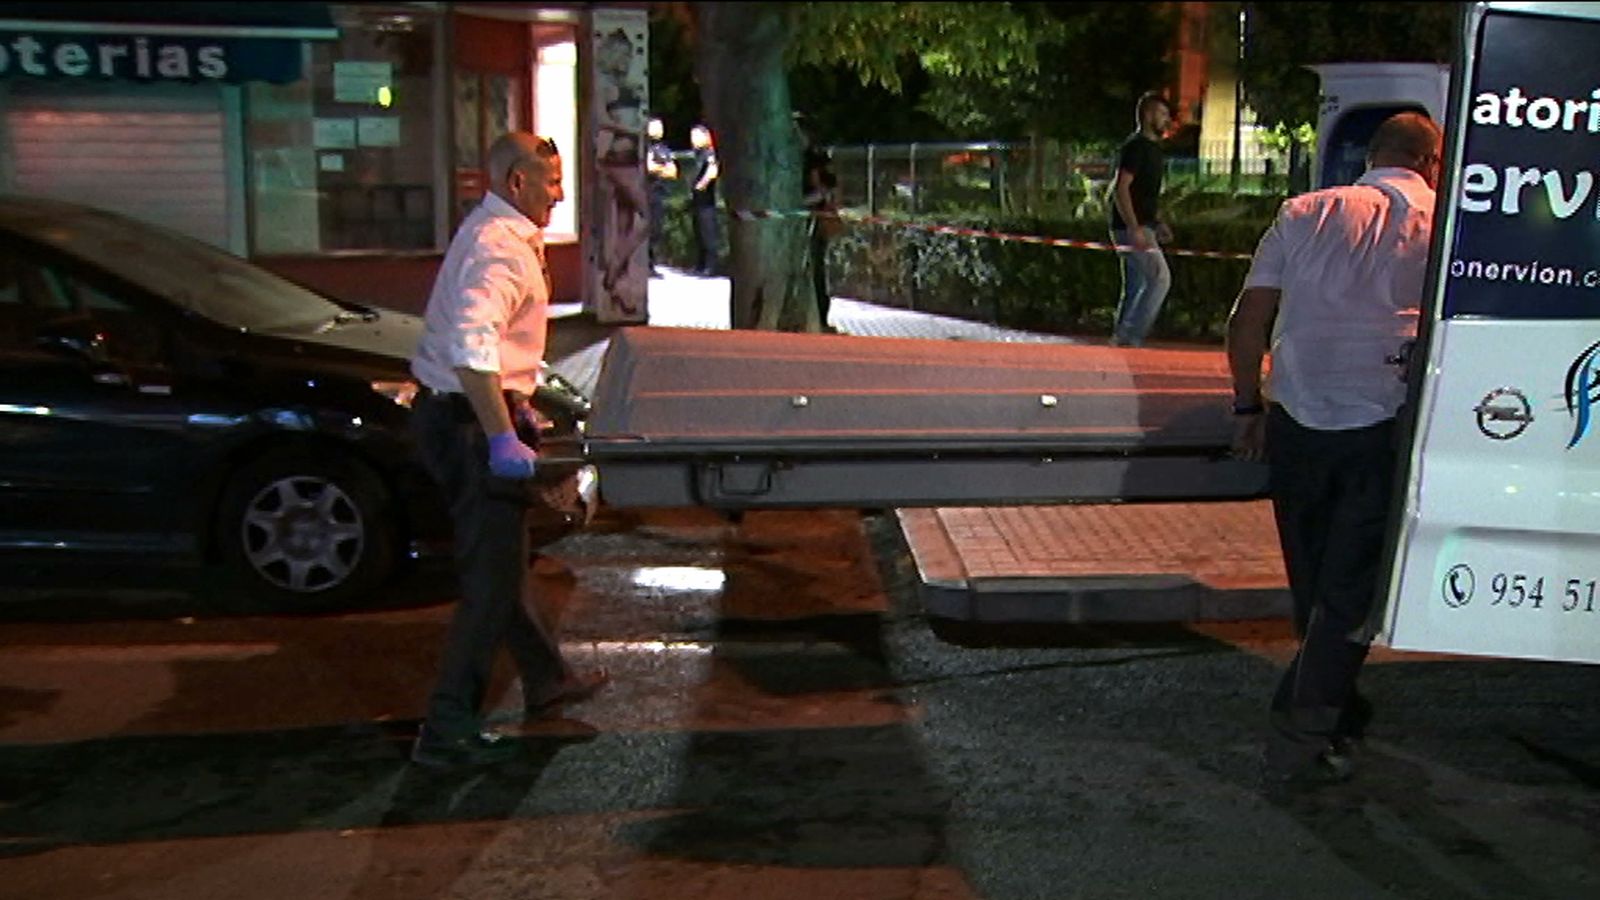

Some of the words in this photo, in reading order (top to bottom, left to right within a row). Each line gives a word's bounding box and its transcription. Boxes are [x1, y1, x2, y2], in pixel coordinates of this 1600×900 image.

[0, 35, 228, 79] terias
[1472, 87, 1600, 132] atori
[1450, 259, 1600, 288] onervion.c
[1490, 573, 1544, 609] 954
